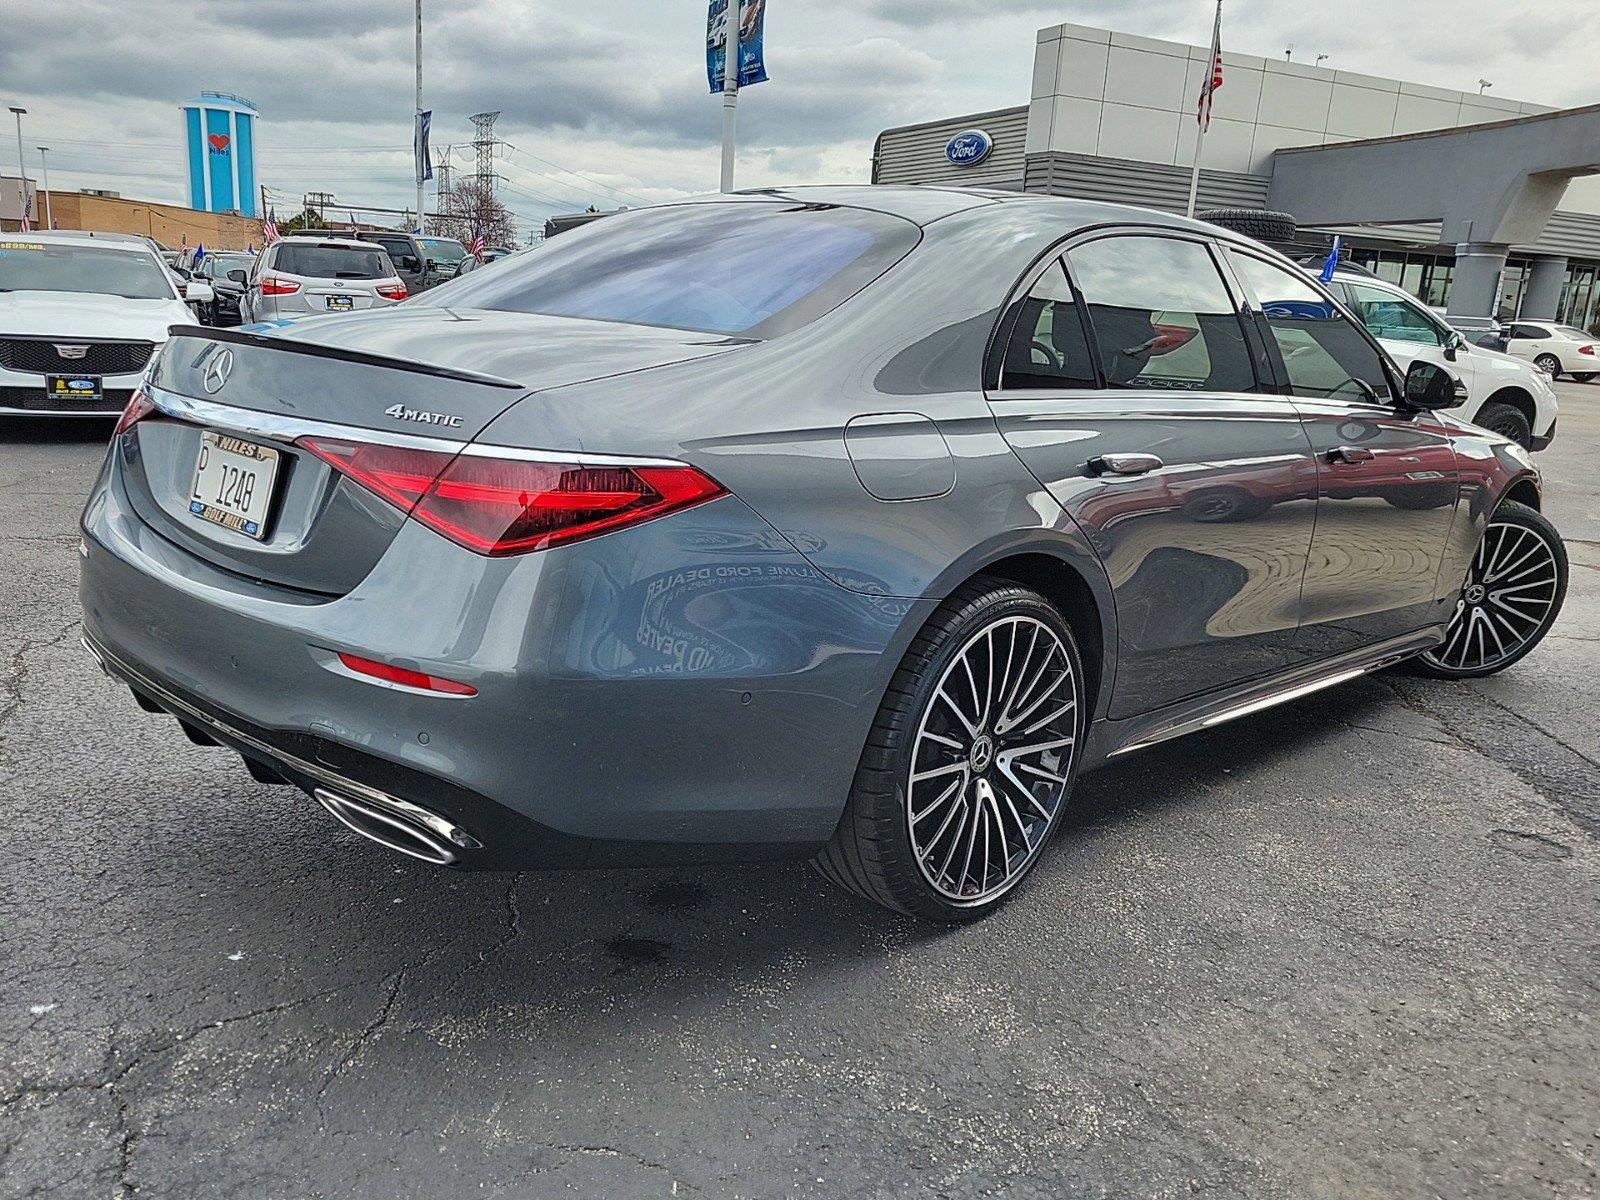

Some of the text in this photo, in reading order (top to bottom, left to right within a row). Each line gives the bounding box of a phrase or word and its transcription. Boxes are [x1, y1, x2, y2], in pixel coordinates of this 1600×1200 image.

[951, 138, 978, 159] Ford
[385, 403, 464, 428] 4MATIC
[219, 436, 256, 457] NILES
[216, 464, 256, 512] 1248
[204, 506, 225, 522] GOLF
[223, 513, 244, 530] MILL
